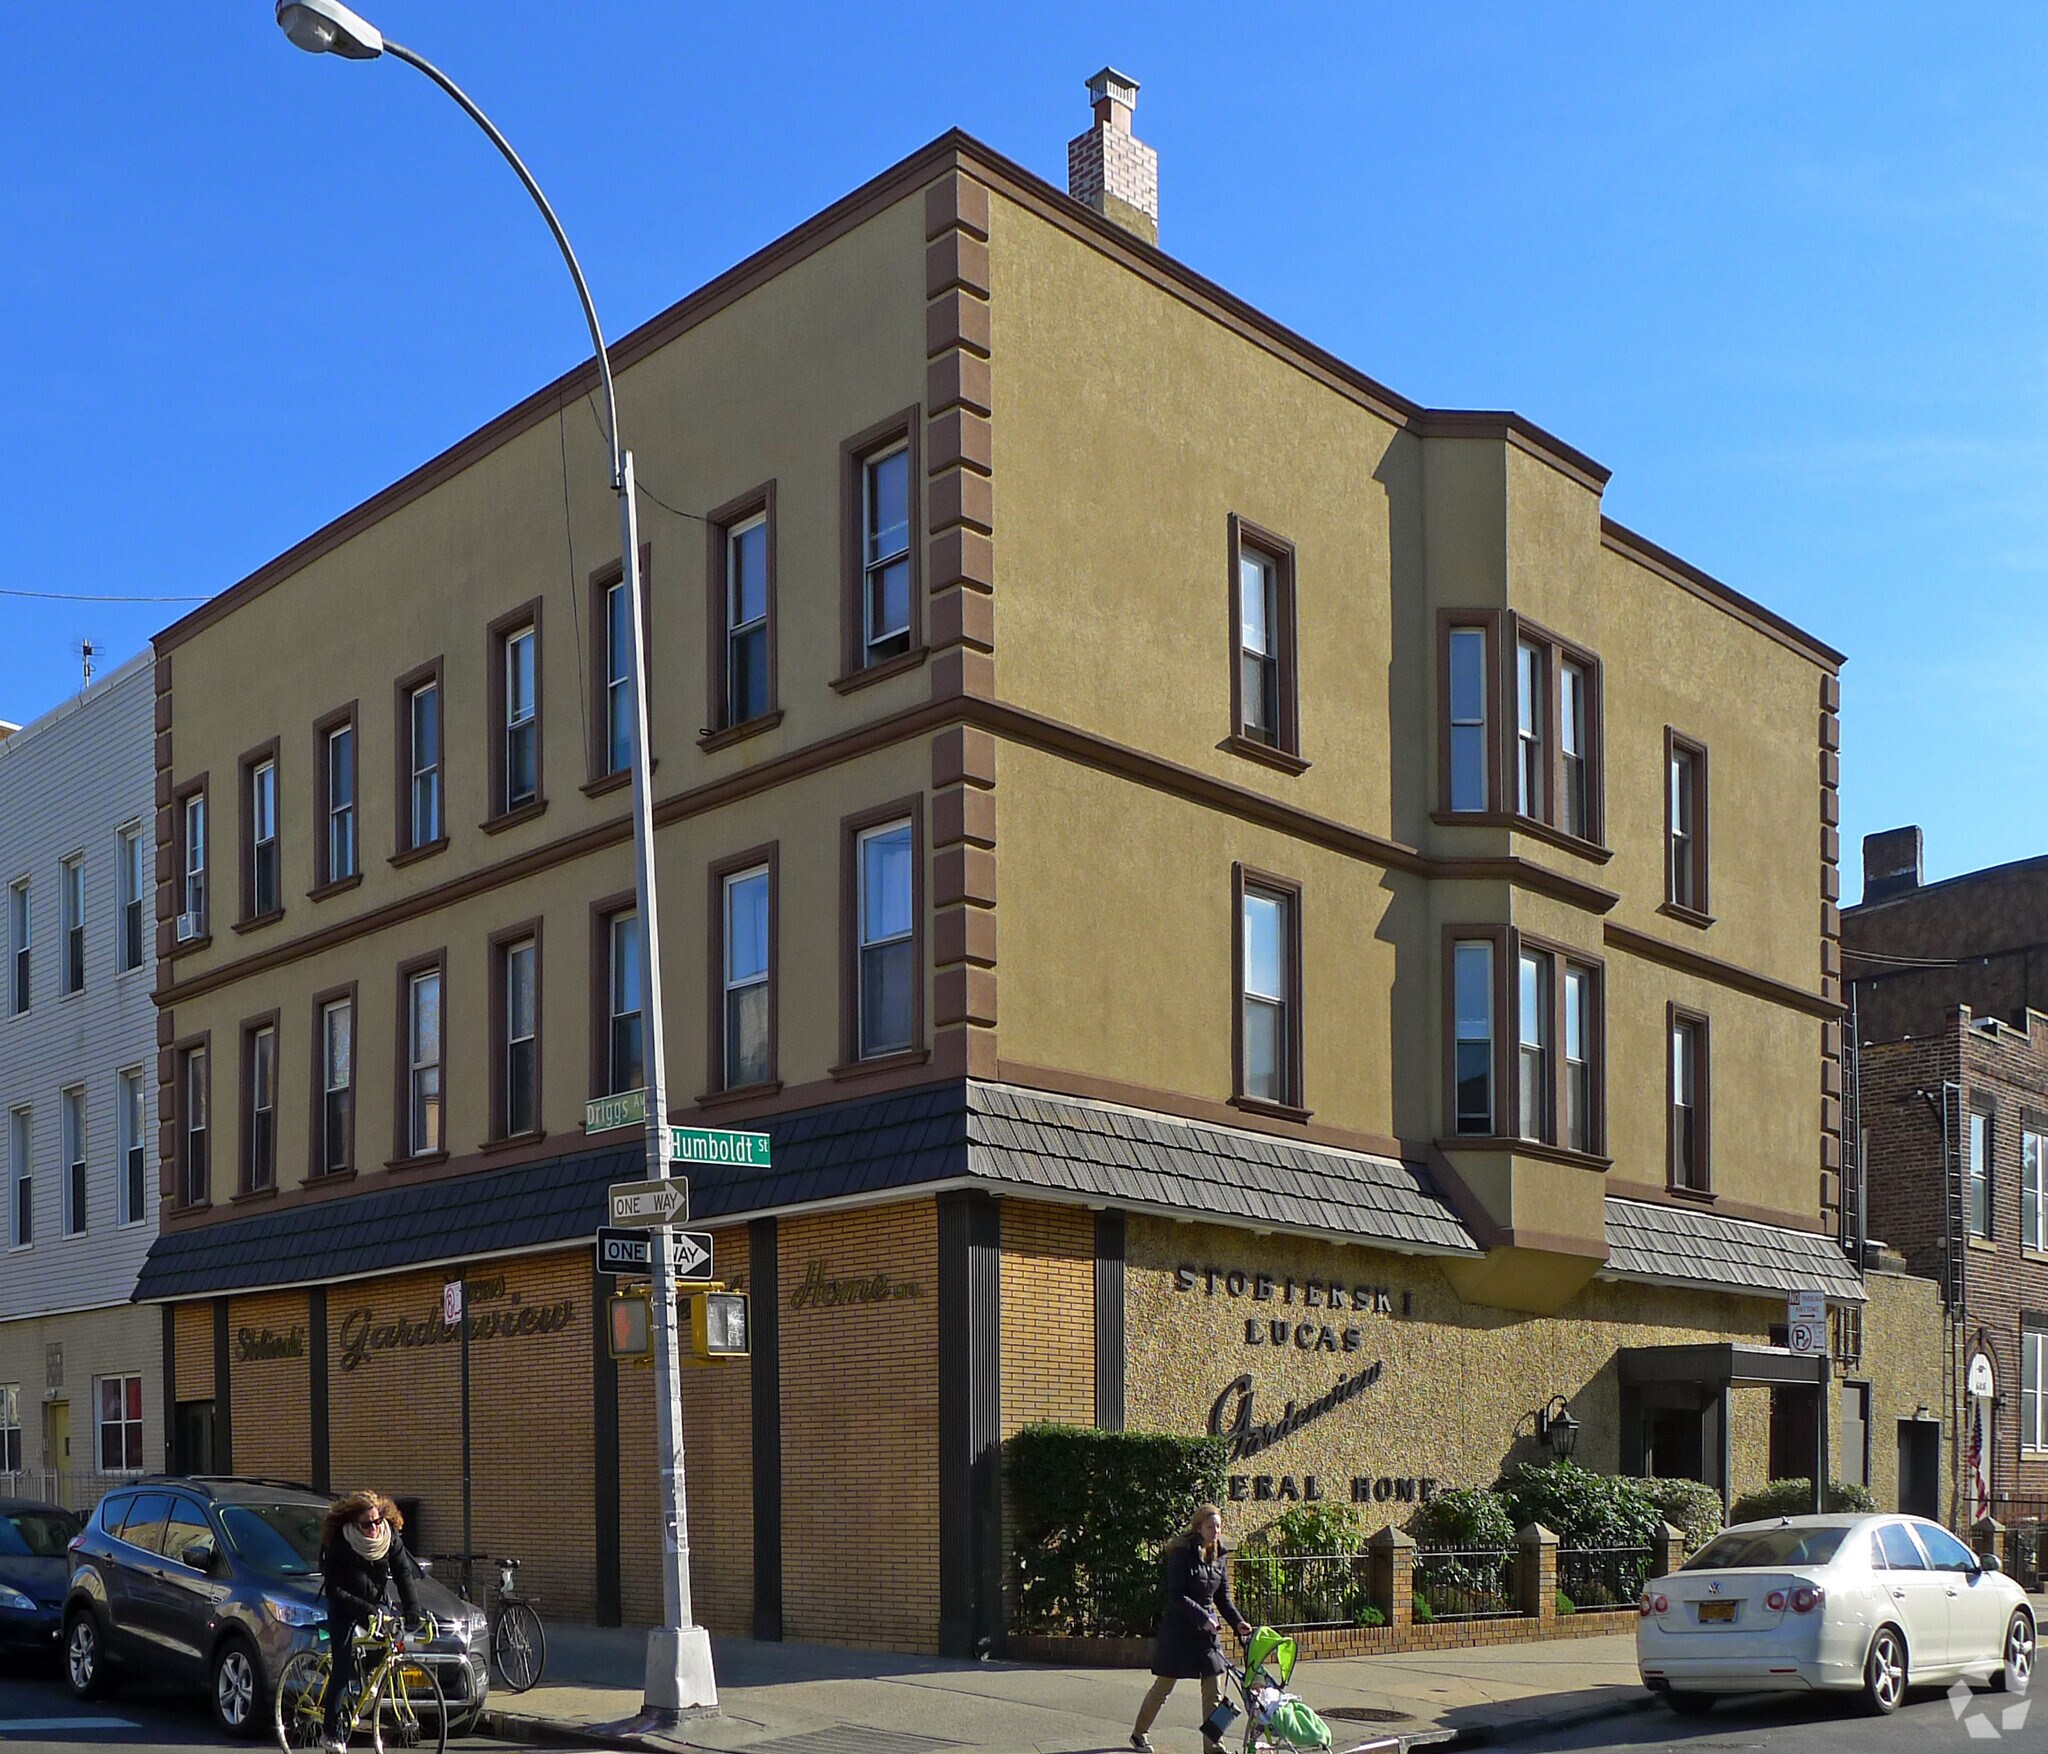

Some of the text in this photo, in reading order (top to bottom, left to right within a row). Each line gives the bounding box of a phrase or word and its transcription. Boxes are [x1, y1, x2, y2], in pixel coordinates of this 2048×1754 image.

[586, 1101, 628, 1126] Driggs
[671, 1132, 768, 1162] Humboldt St
[616, 1192, 678, 1215] ONE WAY
[608, 1242, 645, 1260] ONE
[791, 1258, 890, 1309] Home
[1178, 1263, 1413, 1316] STOBIERSKI
[1245, 1318, 1361, 1351] LUCAS
[1207, 1359, 1383, 1462] Gardenview
[1230, 1475, 1438, 1501] ERAL HOME
